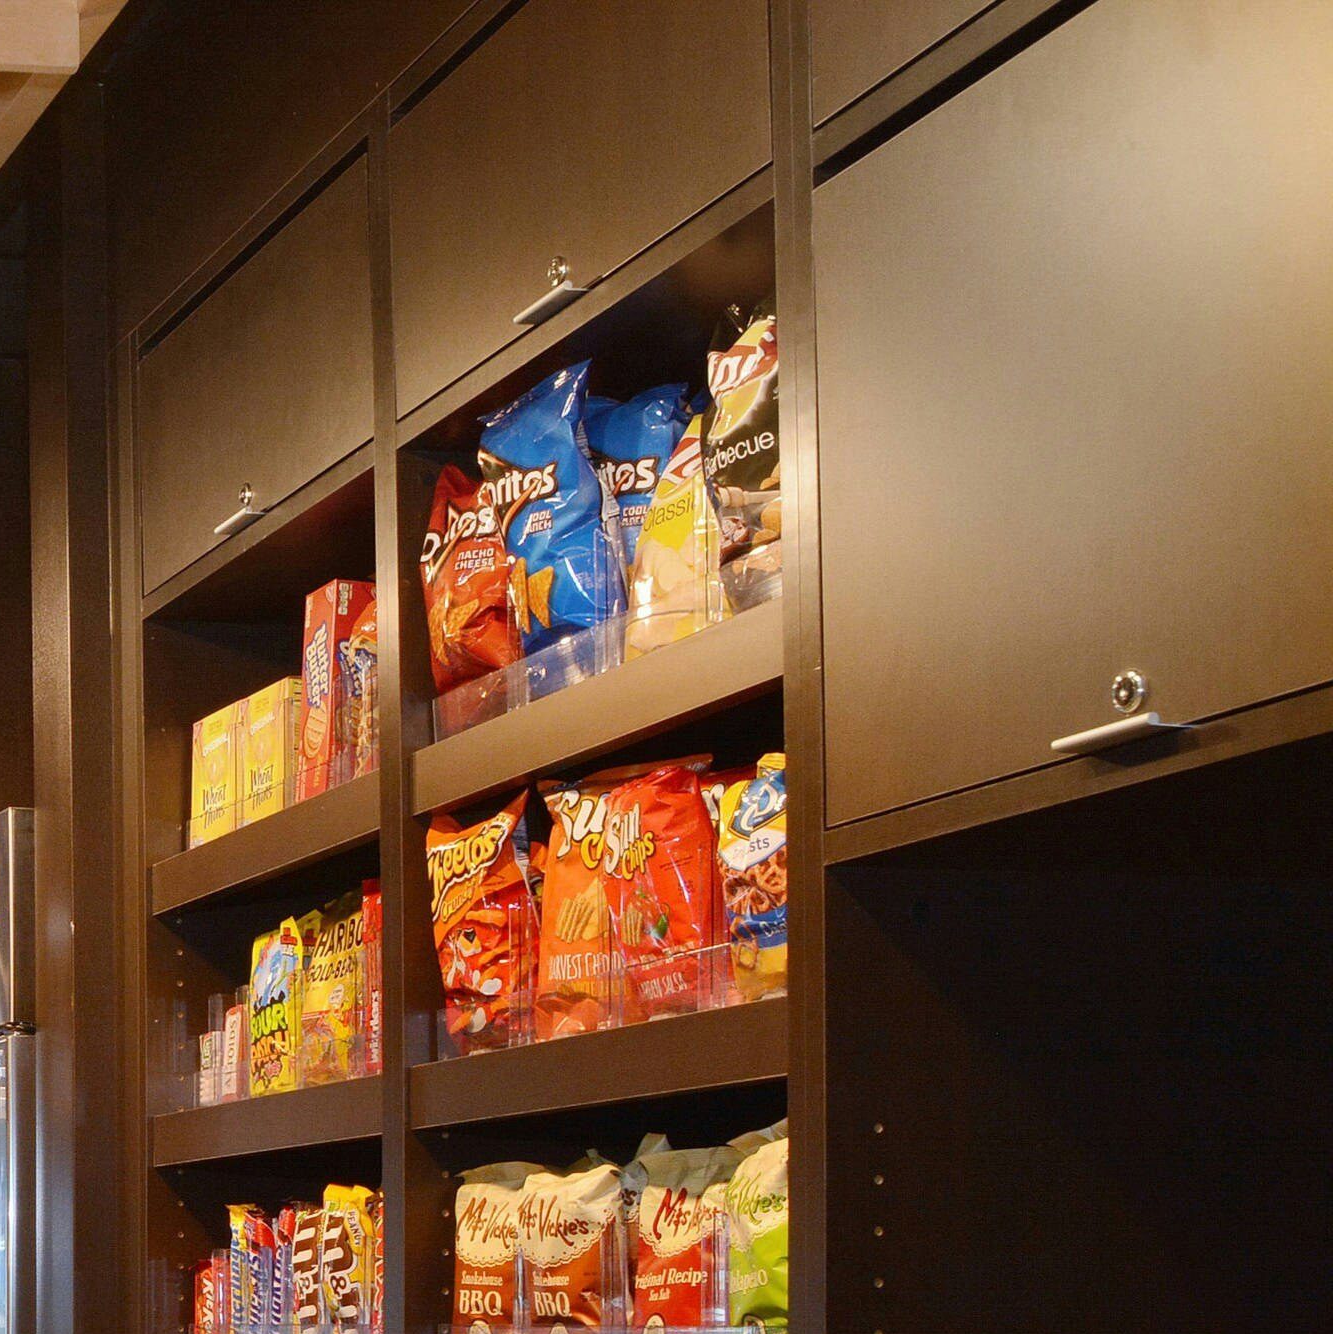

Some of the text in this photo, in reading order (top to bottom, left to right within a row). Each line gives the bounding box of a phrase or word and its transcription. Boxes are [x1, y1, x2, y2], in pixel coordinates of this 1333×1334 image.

[705, 431, 775, 479] Barbecue
[599, 457, 656, 492] itos
[454, 556, 495, 571] CHEESE
[457, 547, 495, 561] NACHO
[553, 789, 611, 859] Su
[347, 1210, 362, 1248] PEANUT
[539, 1194, 590, 1247] Vickie's
[667, 1267, 708, 1288] Recipe
[459, 1289, 504, 1317] BBQ
[533, 1291, 573, 1318] BBQ
